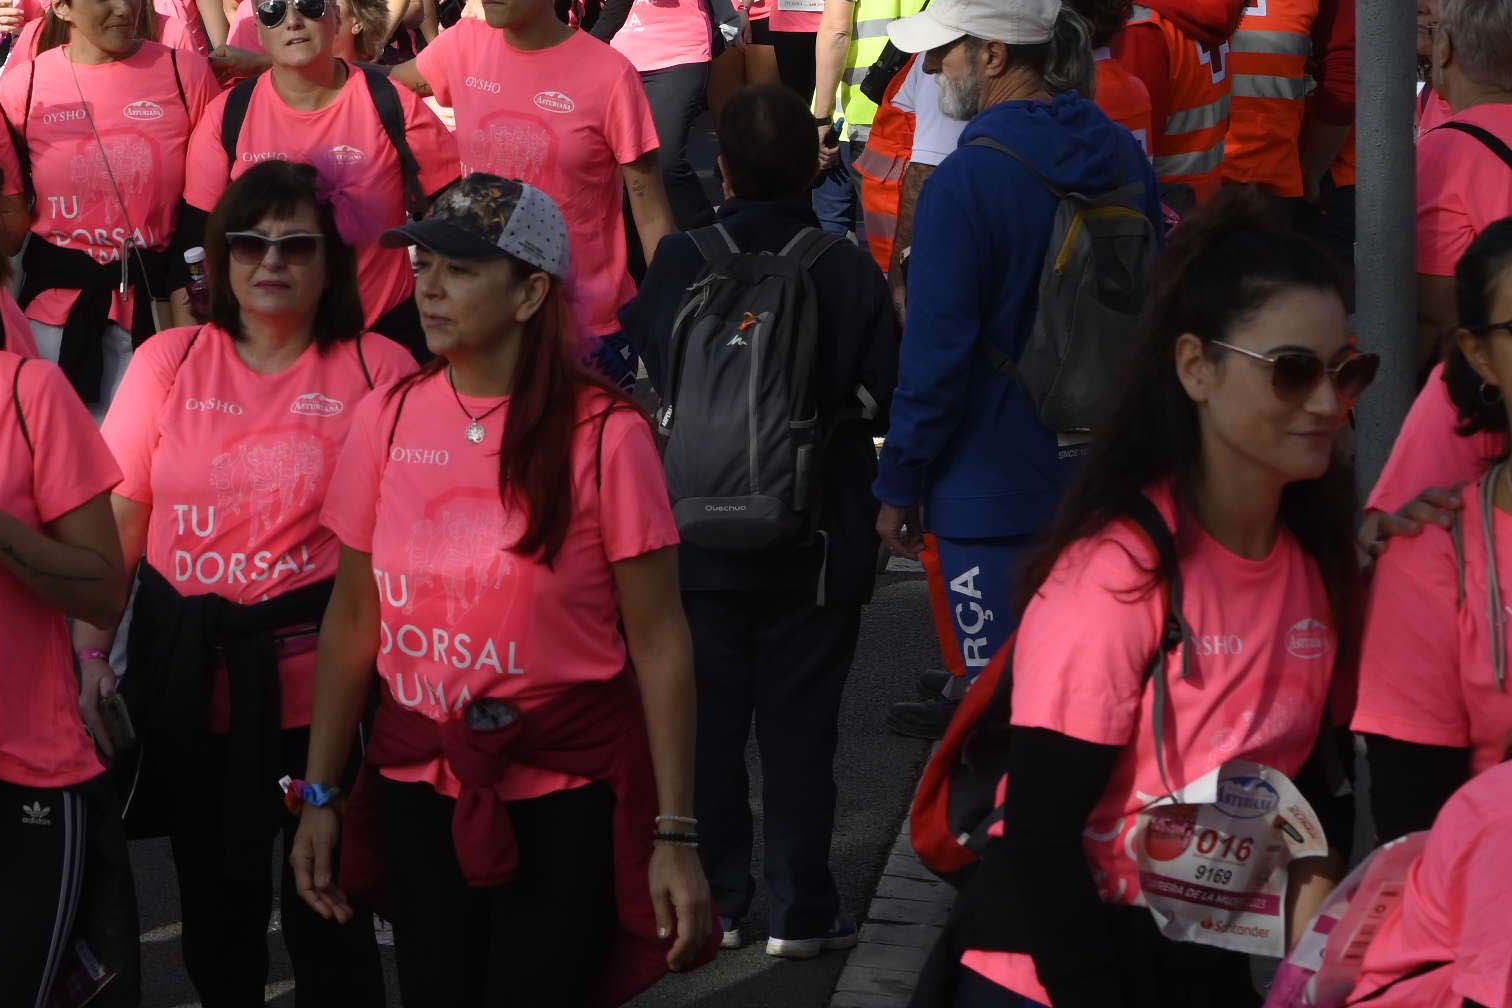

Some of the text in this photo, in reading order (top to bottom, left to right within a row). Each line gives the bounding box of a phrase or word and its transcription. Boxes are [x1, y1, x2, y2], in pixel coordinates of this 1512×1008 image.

[465, 76, 501, 94] OYSHO
[43, 109, 87, 125] OYSHO
[48, 195, 78, 219] TU
[185, 397, 244, 415] OYSHO
[391, 447, 449, 466] OYSHO
[174, 504, 216, 538] TU
[175, 546, 316, 584] DORSAL
[950, 565, 994, 668] RÇA
[1196, 829, 1255, 862] 016
[1194, 864, 1233, 886] 9169
[1214, 918, 1271, 939] Santander
